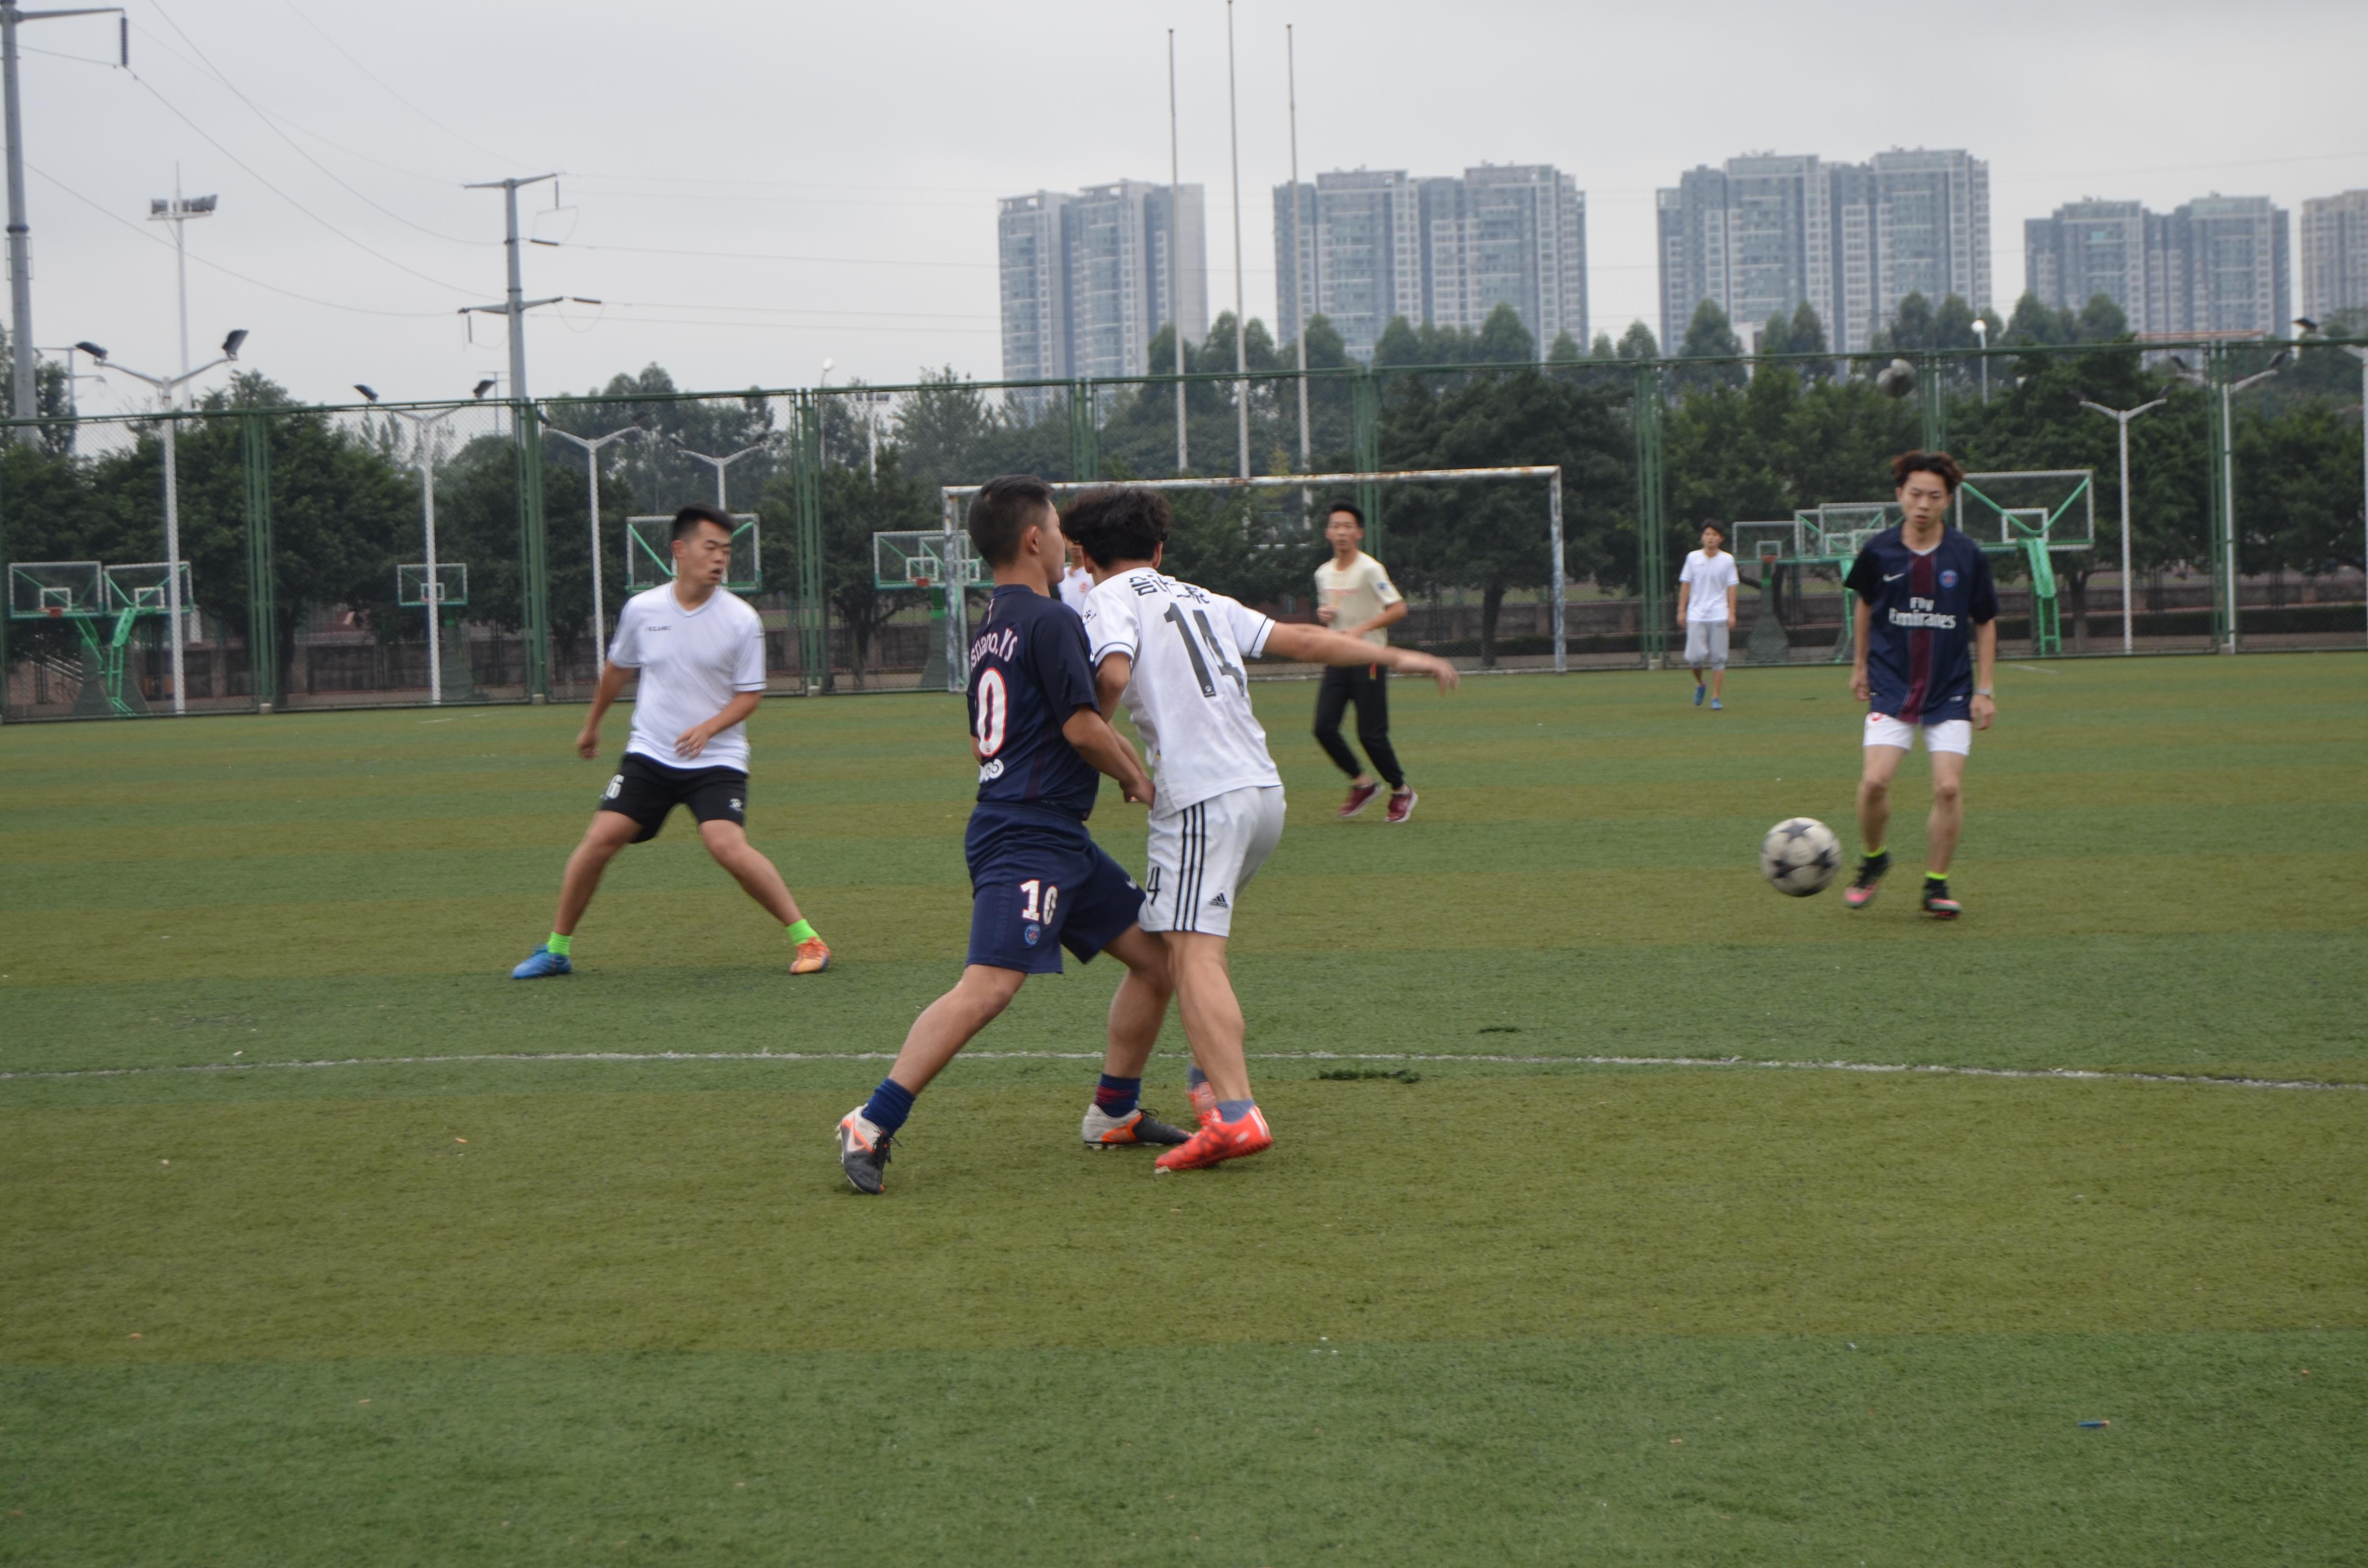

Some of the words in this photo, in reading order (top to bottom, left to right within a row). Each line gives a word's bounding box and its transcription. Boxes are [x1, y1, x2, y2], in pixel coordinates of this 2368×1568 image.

[1909, 597, 1935, 612] Fly
[1888, 607, 1957, 630] Emirates
[1163, 602, 1246, 698] 14
